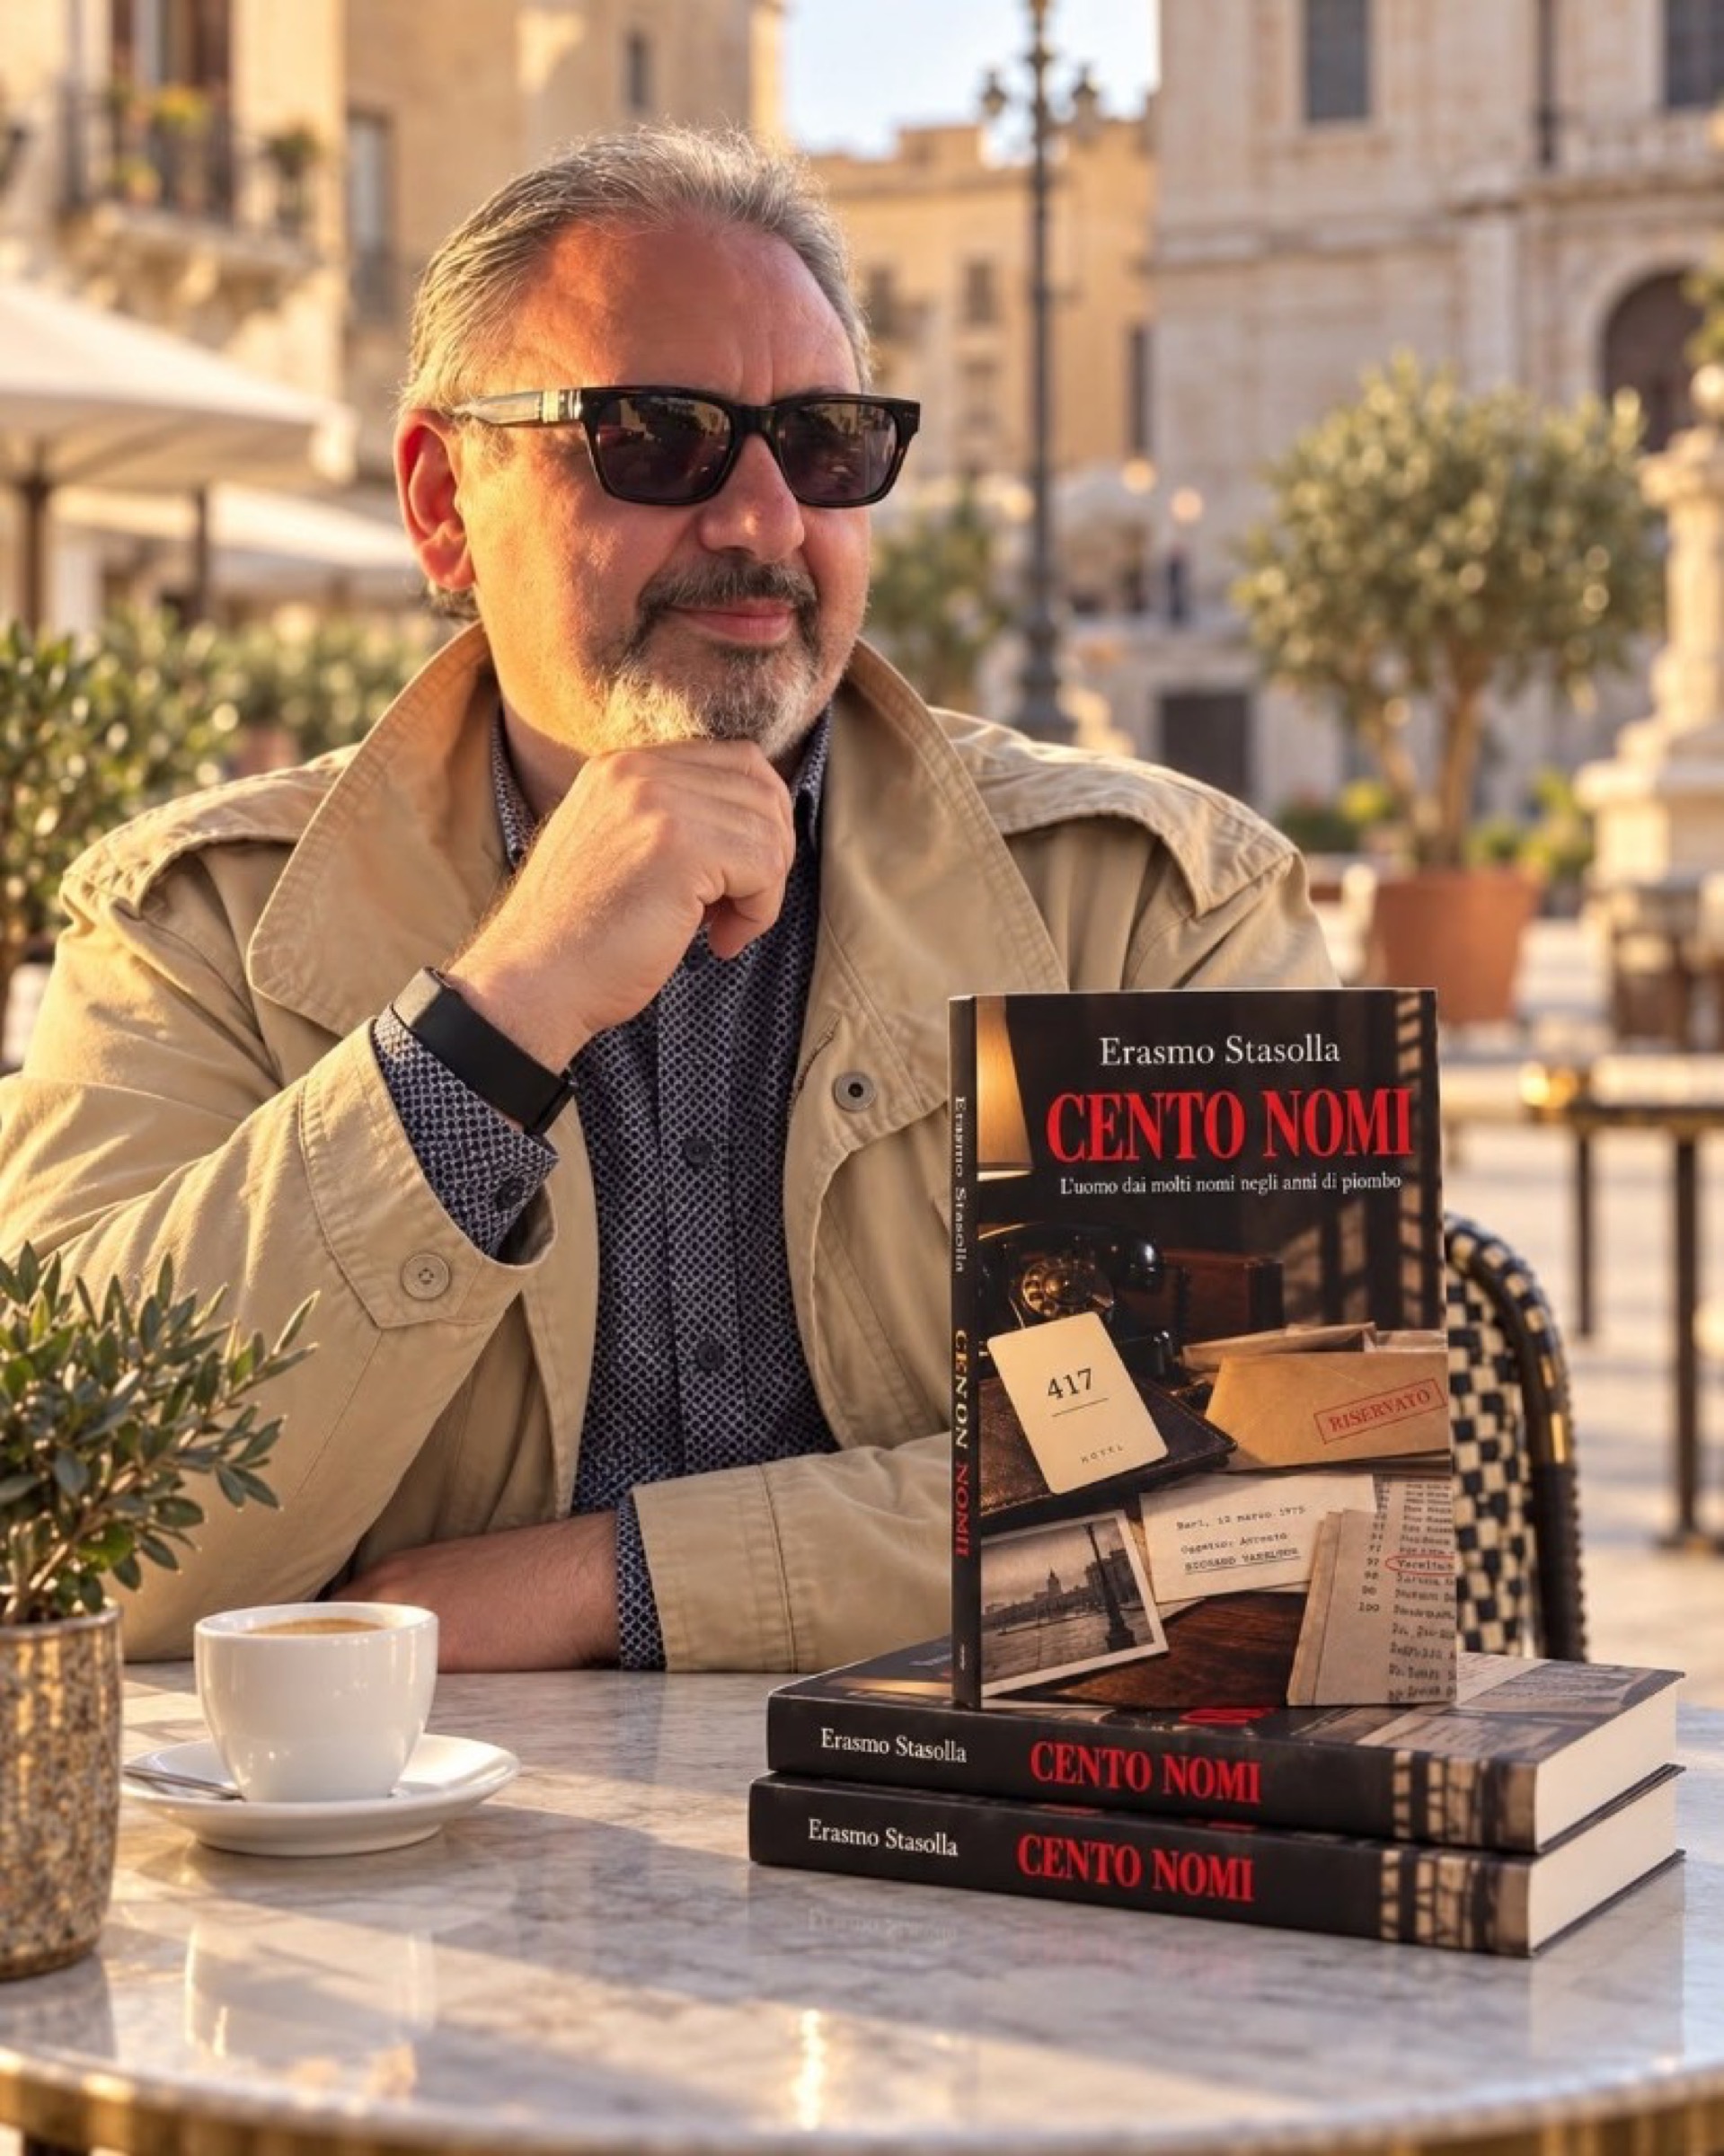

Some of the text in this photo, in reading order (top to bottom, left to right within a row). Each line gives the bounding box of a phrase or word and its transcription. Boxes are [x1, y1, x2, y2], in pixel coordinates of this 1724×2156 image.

[1099, 1033, 1340, 1066] Erasmo Stasolla
[1046, 1087, 1413, 1163] CENTO NOMI
[1060, 1171, 1401, 1197] L'uomo dai molti nomi negli anni di piombo
[1048, 1368, 1092, 1399] 417
[1329, 1389, 1430, 1432] RISERVATO
[821, 1727, 1260, 1804] Erasmo Stasolla CENTO NOMI
[809, 1818, 1254, 1903] Erasmo Stasolla CENTO NOMI
